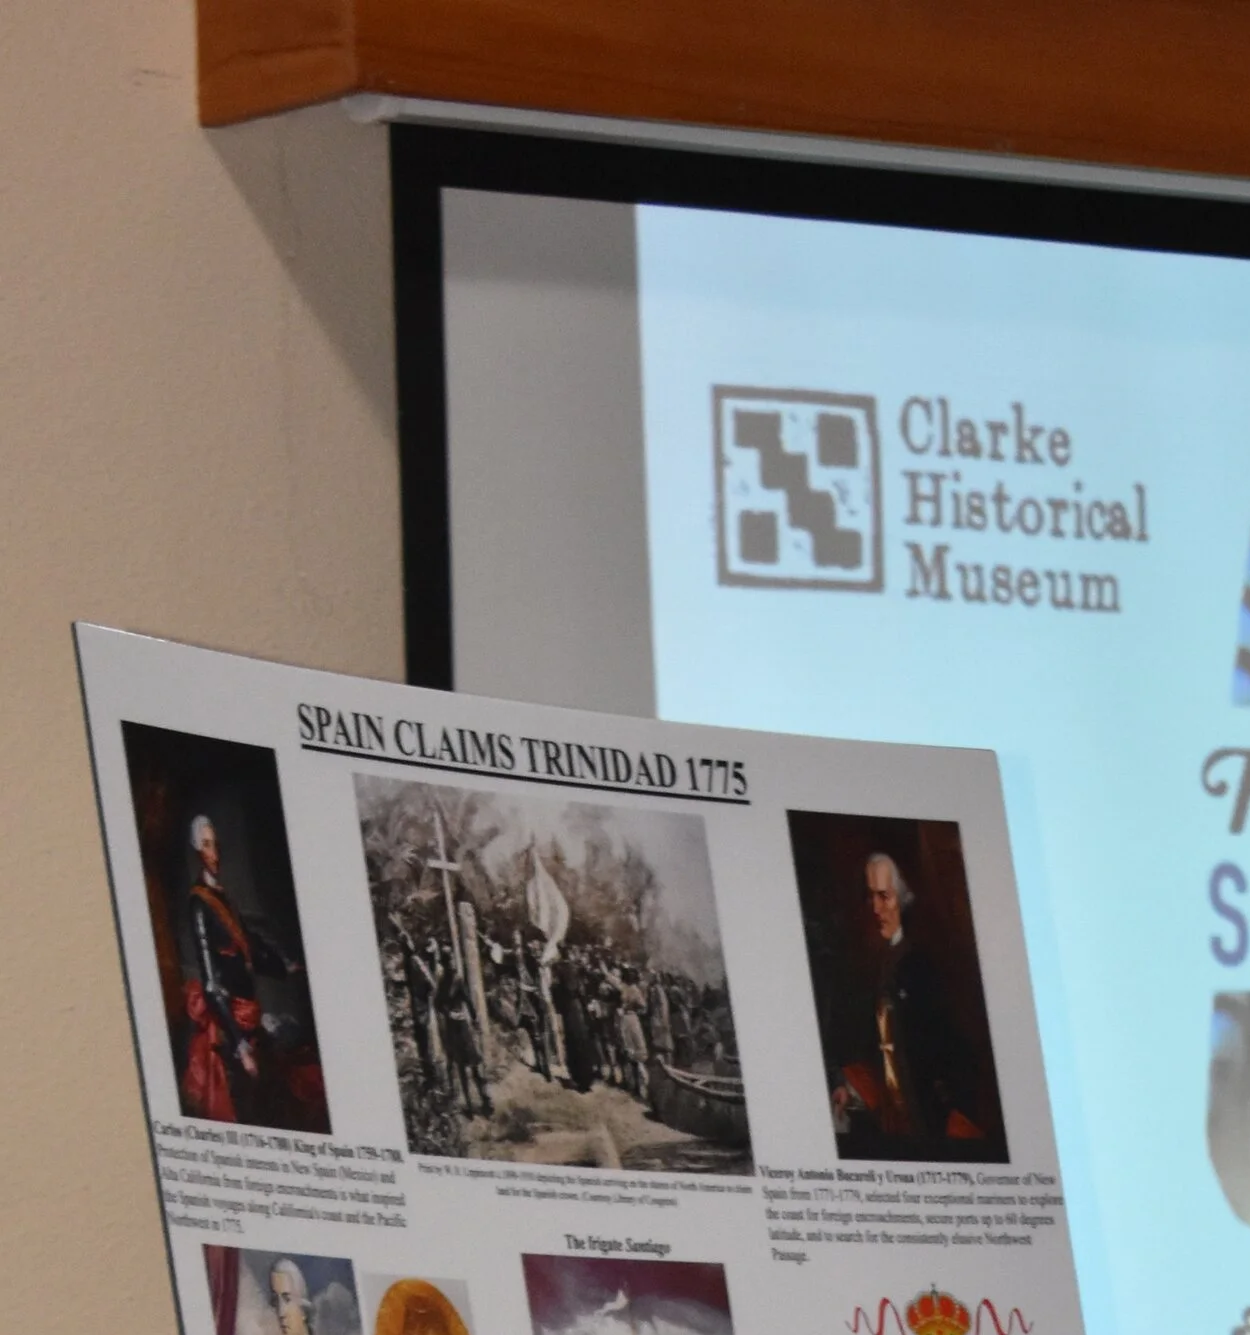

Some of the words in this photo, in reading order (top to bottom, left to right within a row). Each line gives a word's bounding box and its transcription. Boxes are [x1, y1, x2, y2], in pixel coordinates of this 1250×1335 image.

[899, 395, 1072, 467] Clarke
[902, 470, 1149, 542] Historical
[903, 542, 1121, 613] Museum
[297, 702, 386, 751] SPAIN
[394, 718, 516, 772] CLAIMS
[520, 736, 678, 789] TRINIDAD
[685, 756, 749, 797] 1775
